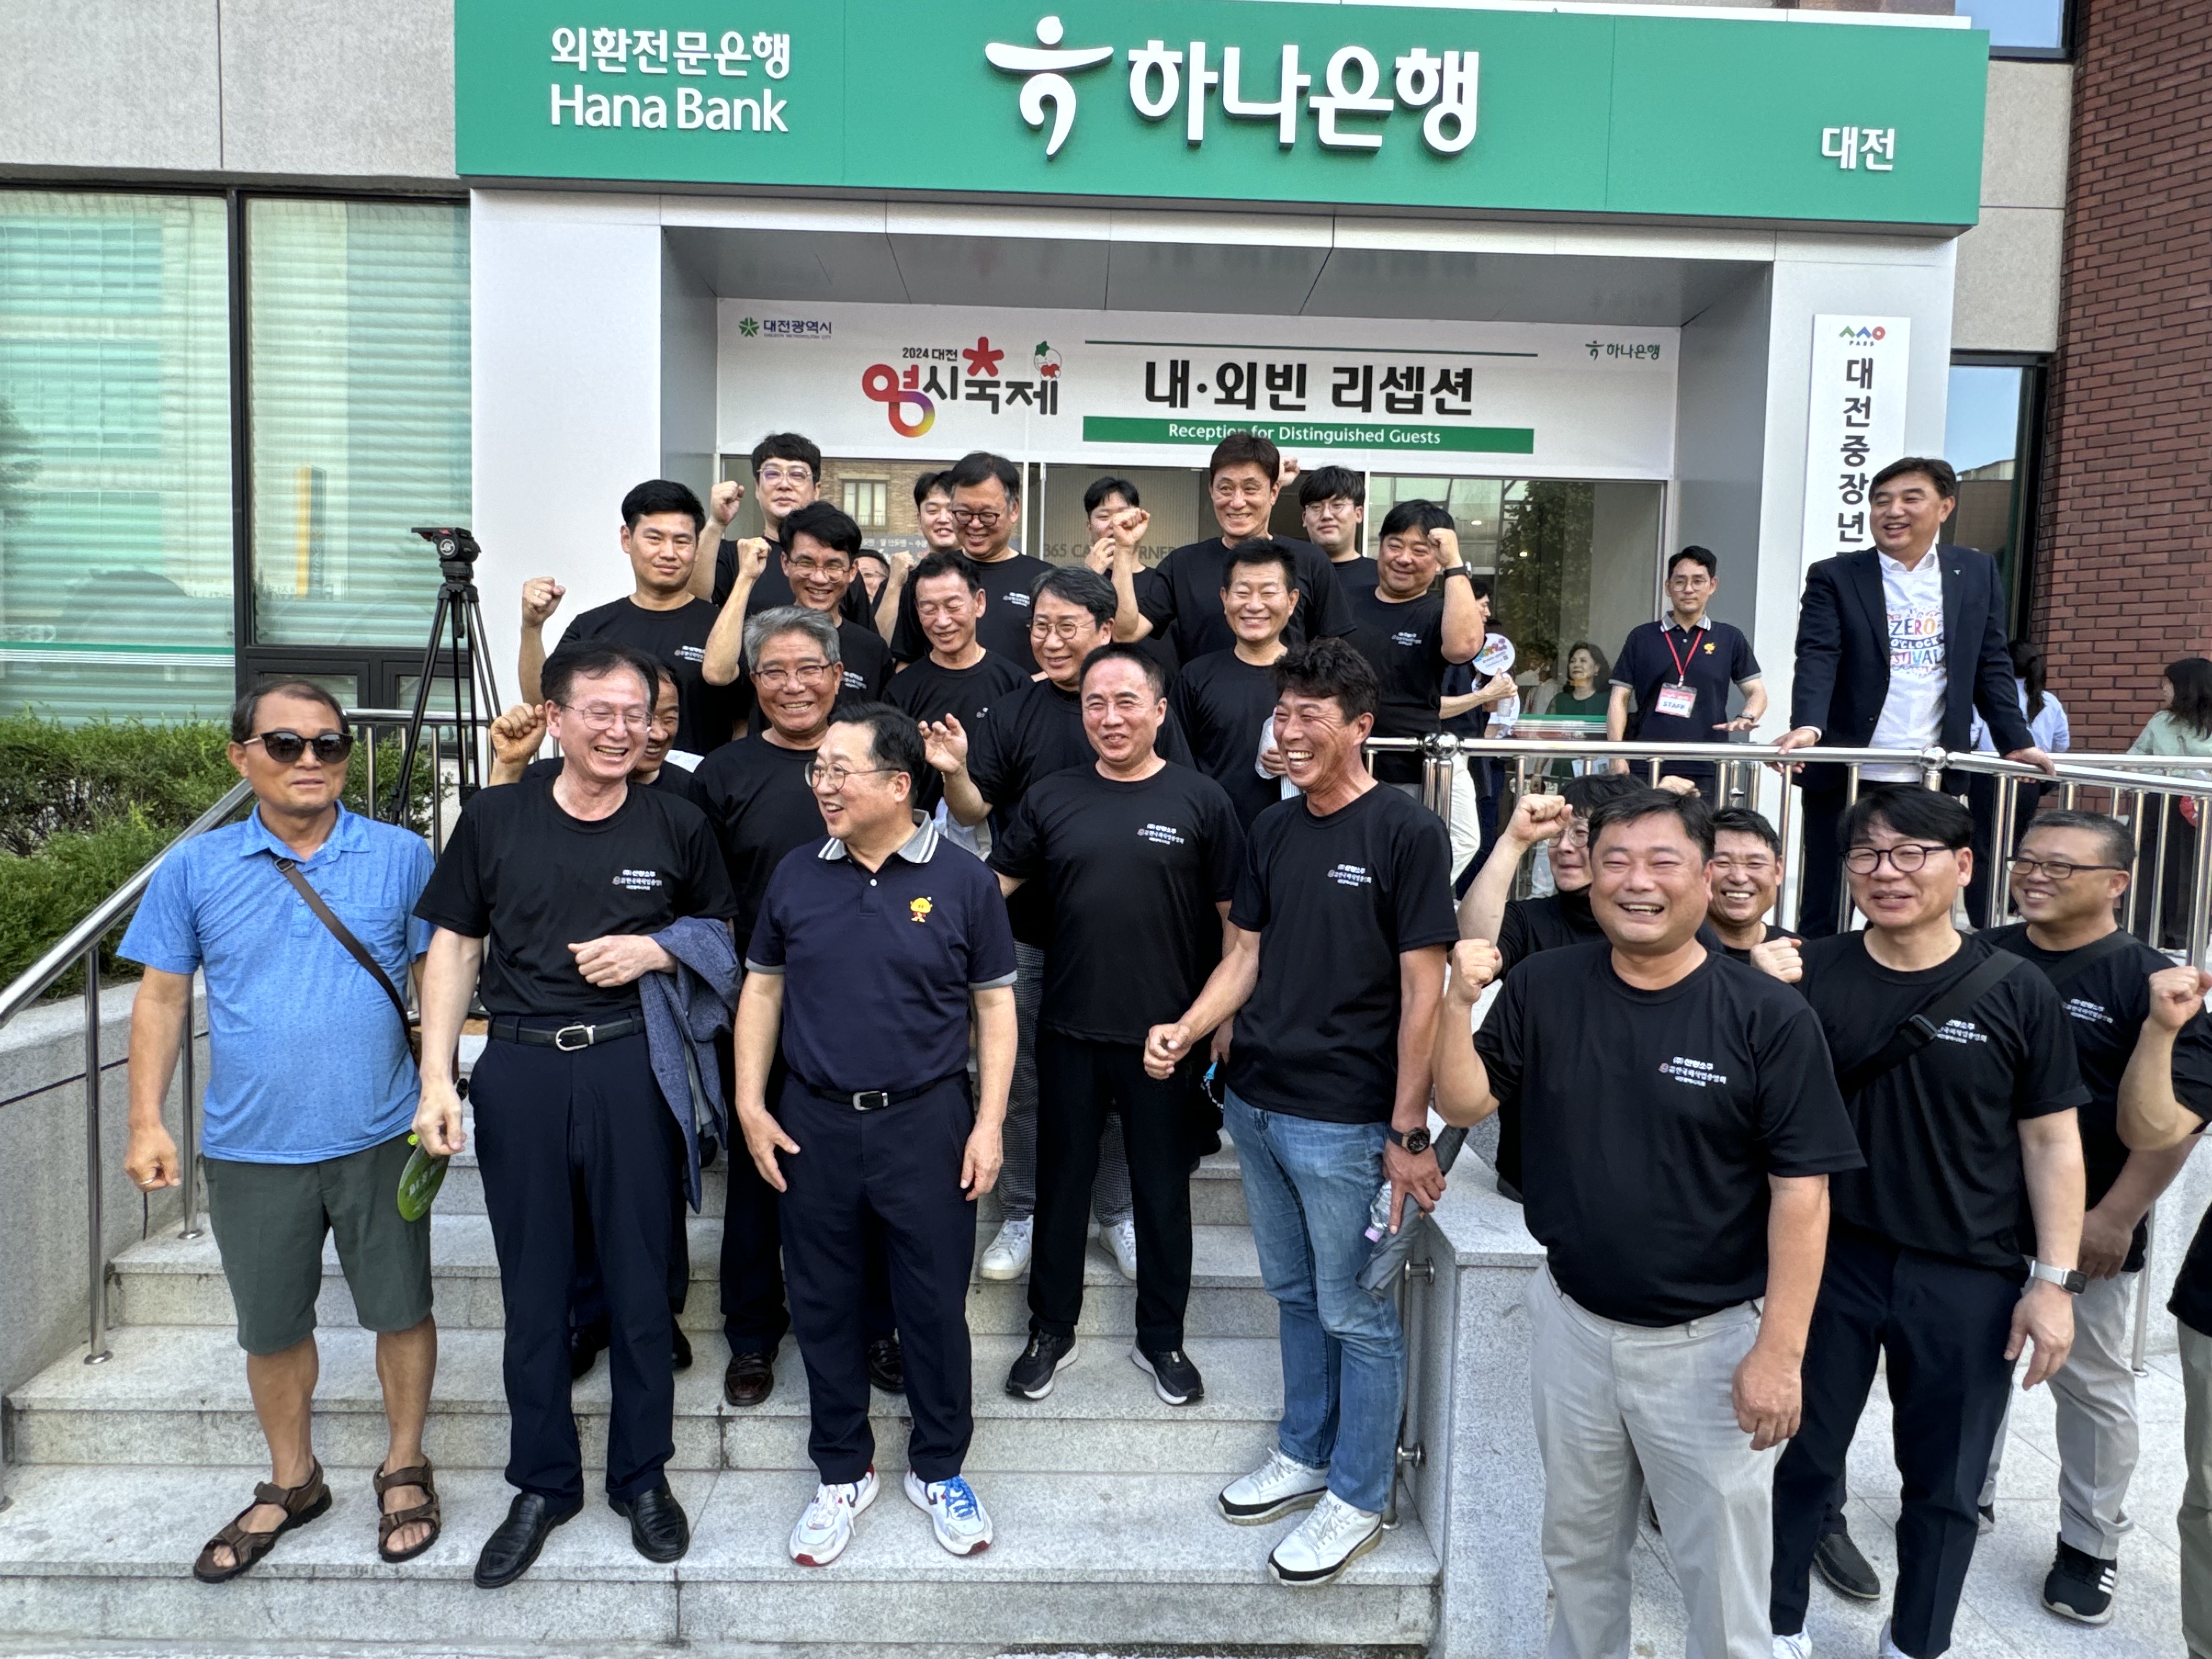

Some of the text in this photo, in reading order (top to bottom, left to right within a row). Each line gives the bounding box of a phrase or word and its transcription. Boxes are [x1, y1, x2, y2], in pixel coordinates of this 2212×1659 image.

[551, 27, 790, 78] 외환전문은행
[1128, 40, 1479, 153] 하나은행
[551, 83, 789, 132] Hana Bank
[1821, 126, 1895, 171] 대전
[764, 319, 832, 335] 대전광역시
[902, 347, 958, 362] 2024 대전
[1606, 343, 1660, 360] 하나은행
[1145, 359, 1473, 416] 내·외빈 리셉션
[1251, 425, 1275, 439] for
[1279, 426, 1384, 445] Distinguished
[1389, 430, 1441, 444] Guests
[1890, 618, 1936, 635] ZERO
[1891, 637, 1939, 649] O'CLOCK
[1891, 650, 1944, 665] STIVAL
[1662, 700, 1685, 710] STAFF
